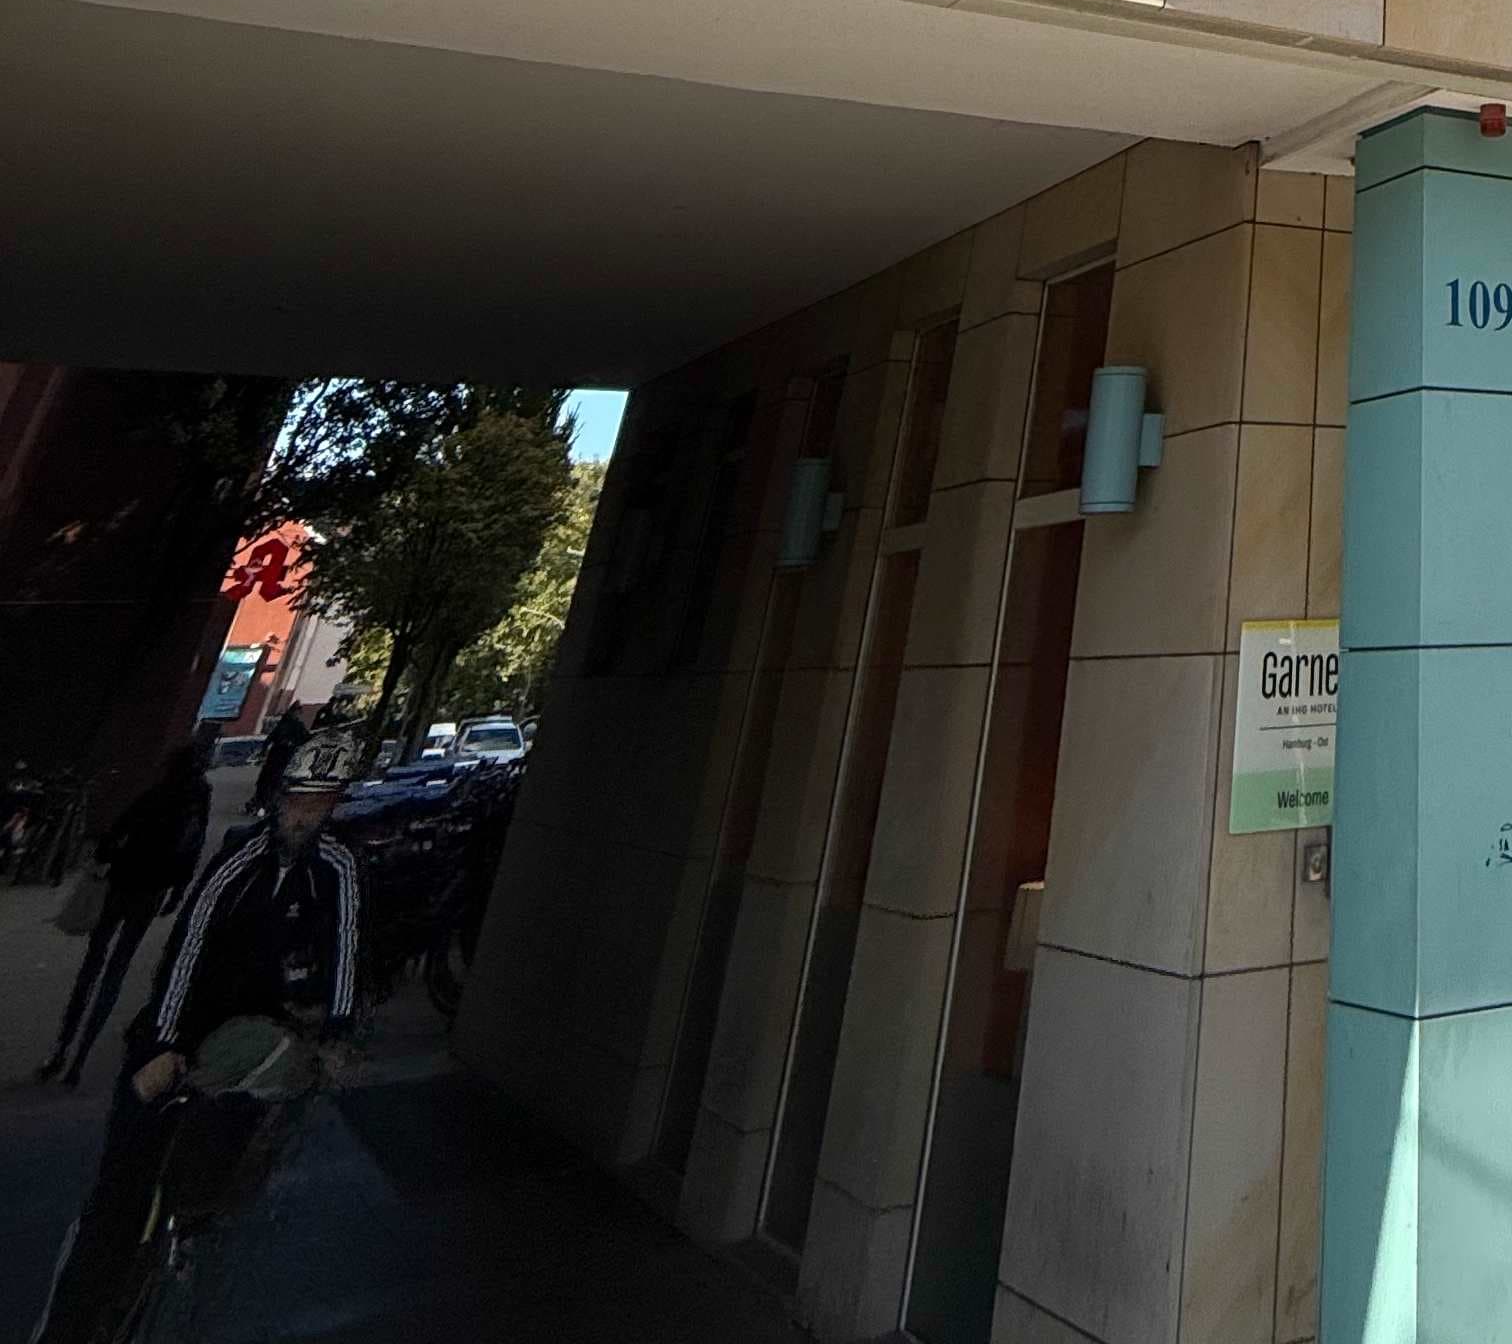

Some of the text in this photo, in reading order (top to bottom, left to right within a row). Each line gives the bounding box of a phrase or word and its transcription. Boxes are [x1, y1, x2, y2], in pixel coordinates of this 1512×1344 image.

[1261, 650, 1339, 700] Garne
[1276, 706, 1290, 716] AN
[1310, 703, 1337, 714] HOTEL
[1282, 738, 1312, 752] Hamburg
[1277, 789, 1329, 809] Welcome
